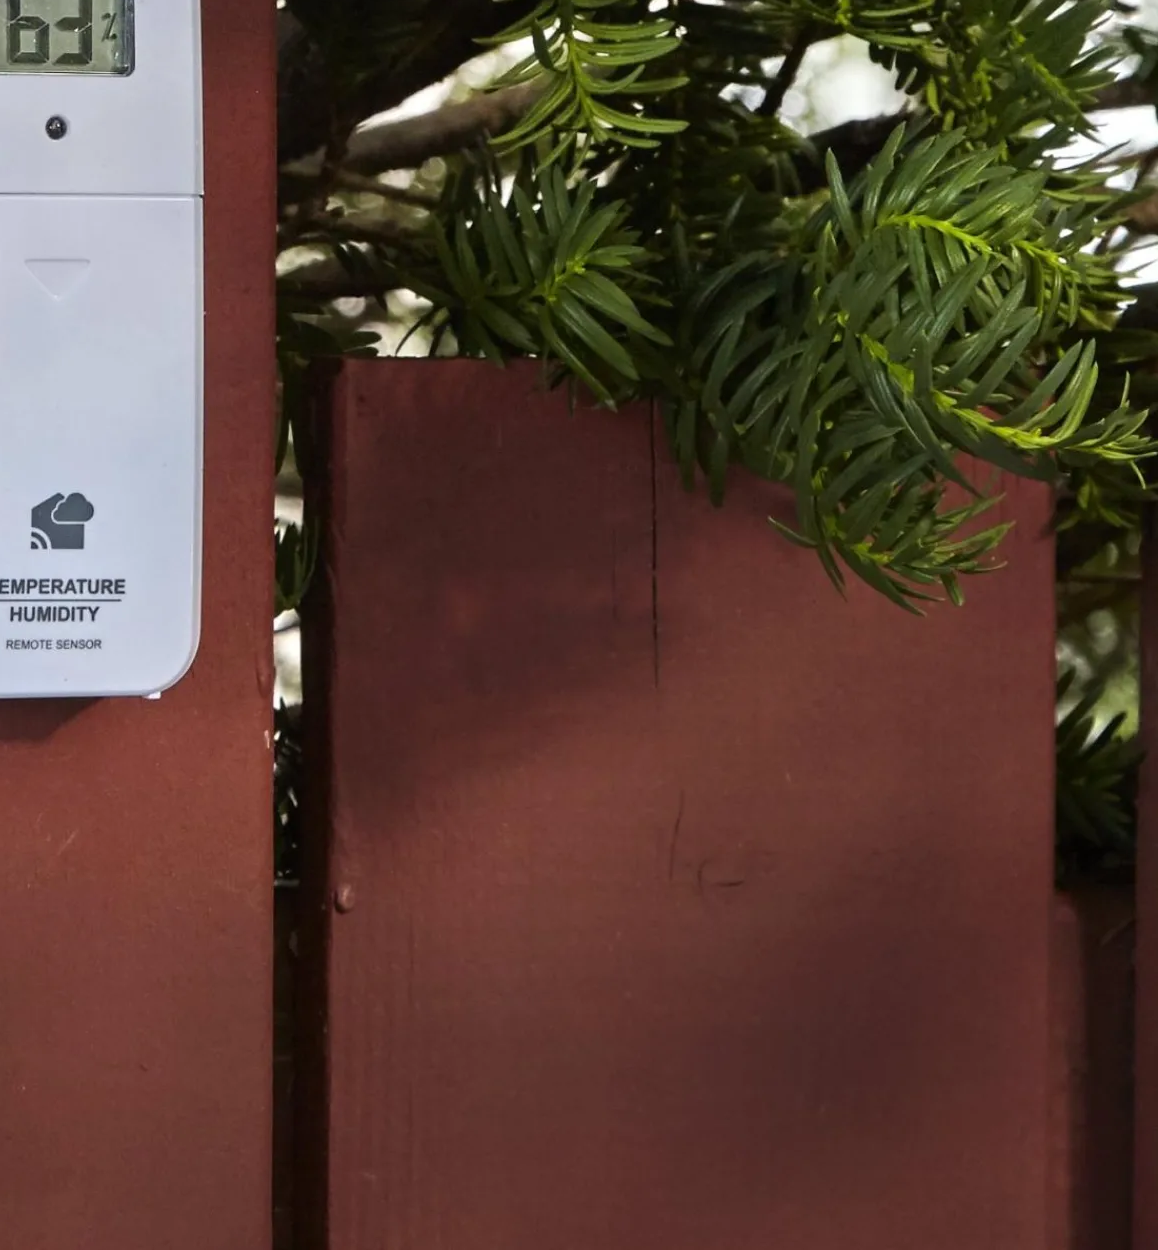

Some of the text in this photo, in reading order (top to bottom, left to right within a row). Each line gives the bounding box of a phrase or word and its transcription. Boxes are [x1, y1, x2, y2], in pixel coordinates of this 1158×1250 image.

[9, 606, 100, 623] HUMIDITY
[5, 639, 102, 650] REMOTE SENSOR
